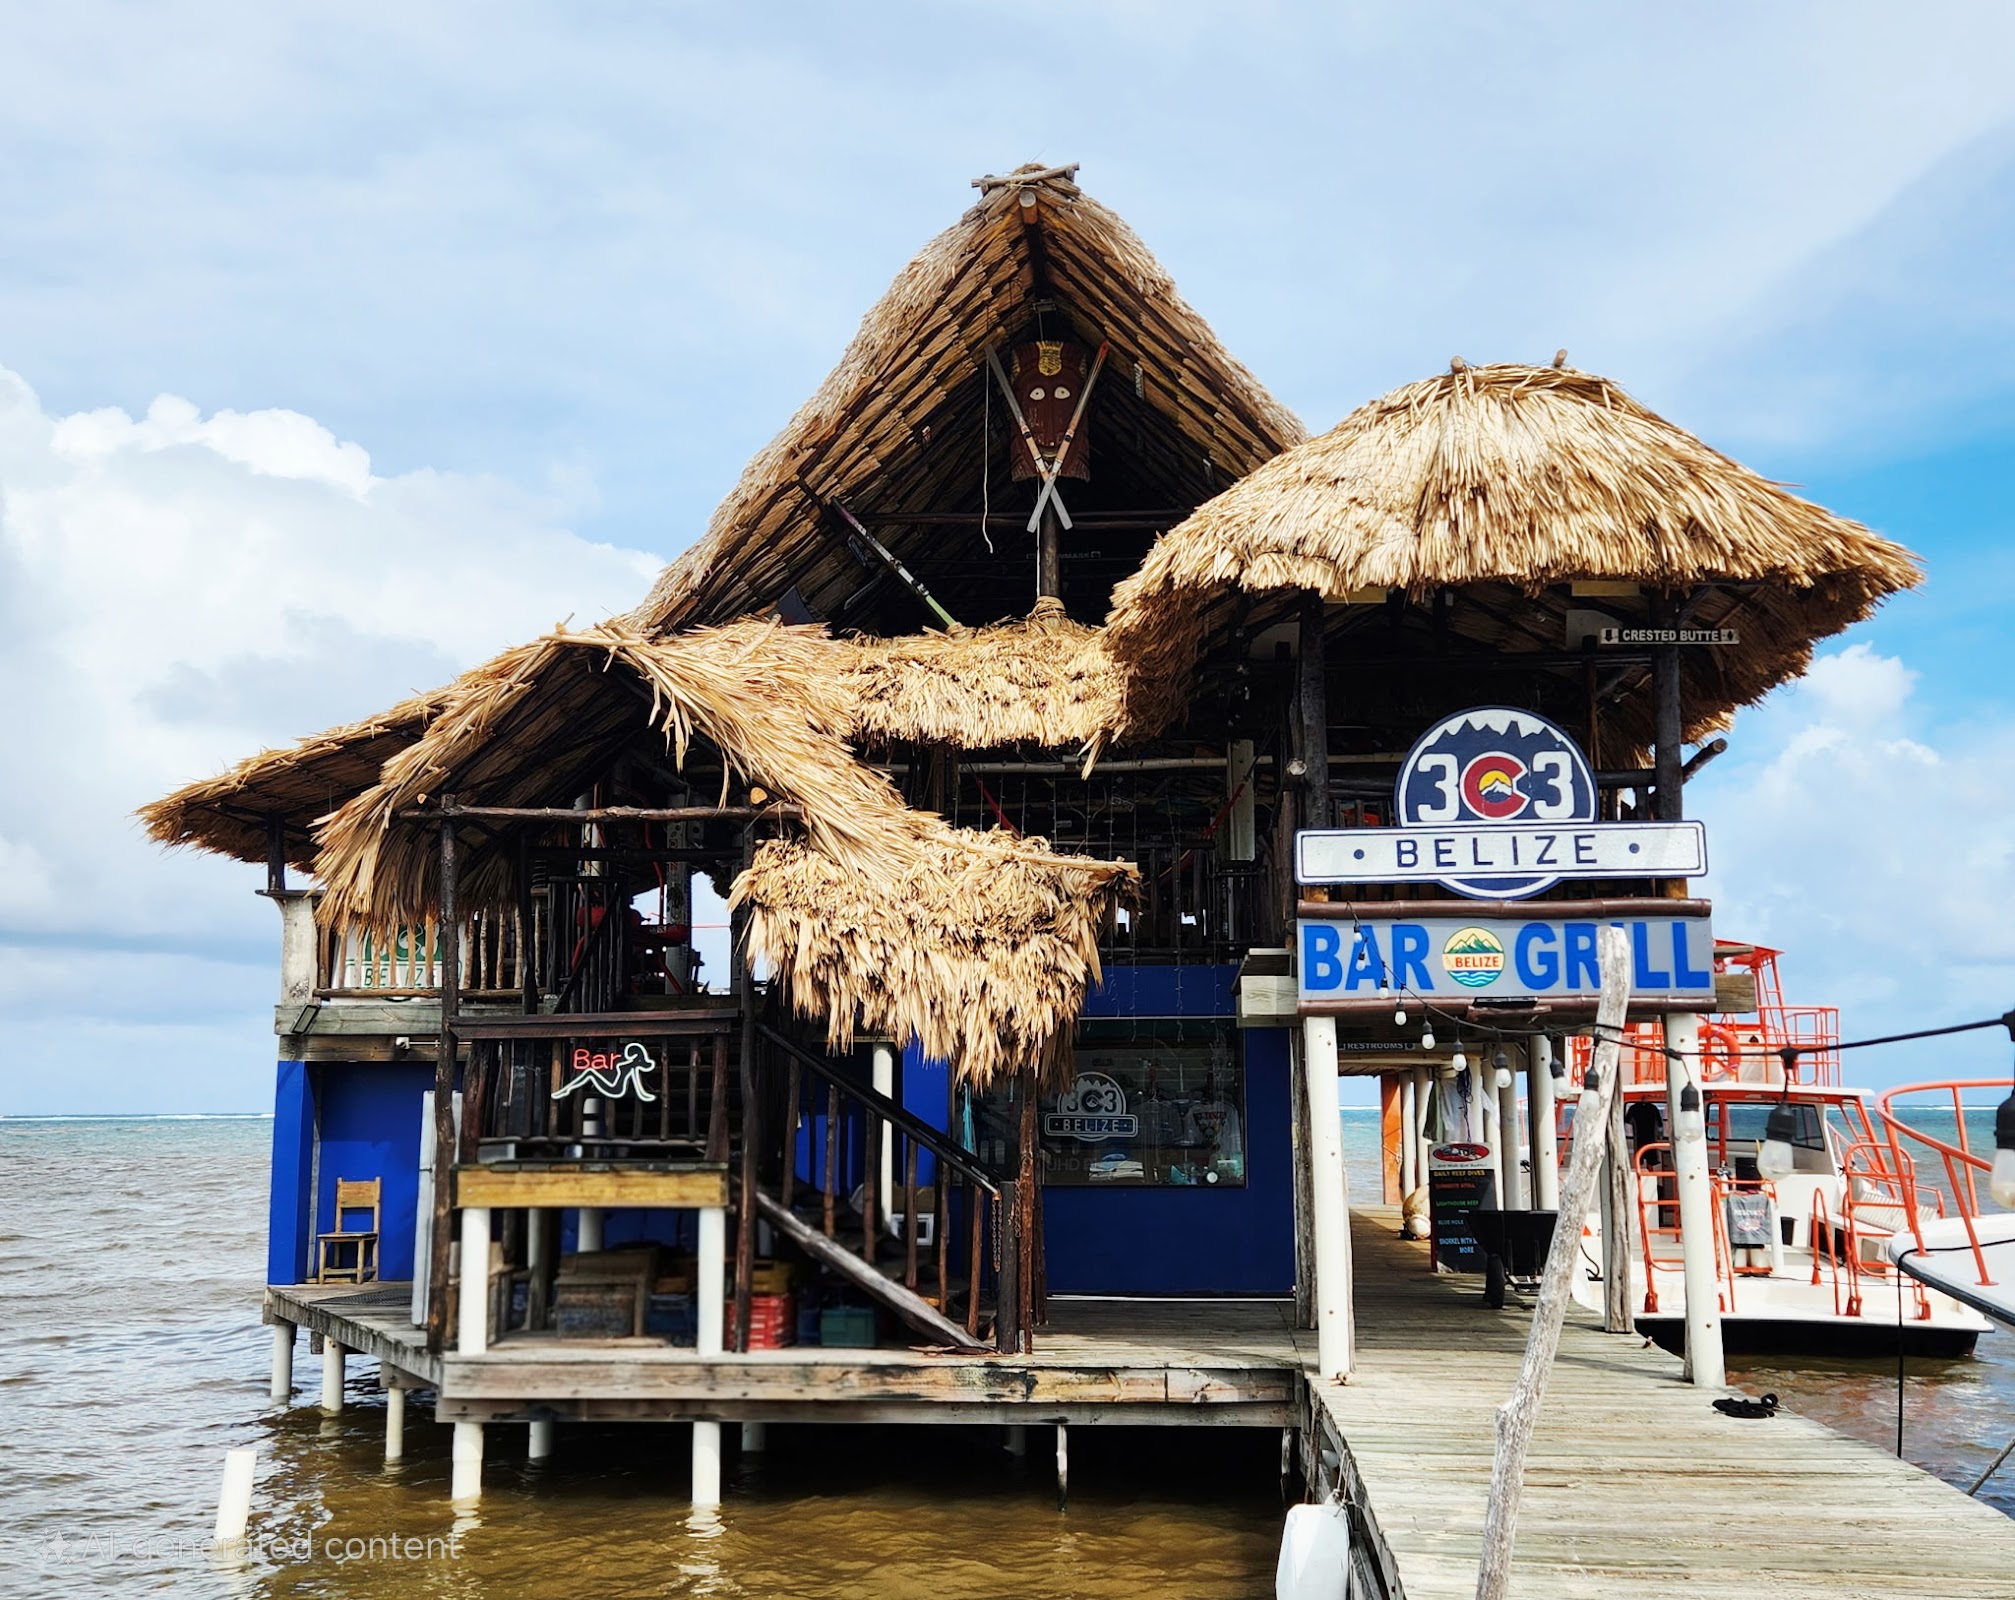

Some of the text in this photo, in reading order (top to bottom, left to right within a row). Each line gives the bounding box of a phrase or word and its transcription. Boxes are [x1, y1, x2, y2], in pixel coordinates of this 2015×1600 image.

[1622, 629, 1719, 642] CRESTED BUTTE
[1395, 834, 1599, 869] BELIZE
[1303, 920, 1711, 992] BAR GRLL
[1455, 953, 1500, 969] BELIZE
[1347, 1042, 1404, 1050] RESTROOMS
[573, 1048, 622, 1071] Bar
[1063, 1118, 1120, 1132] BELIZE
